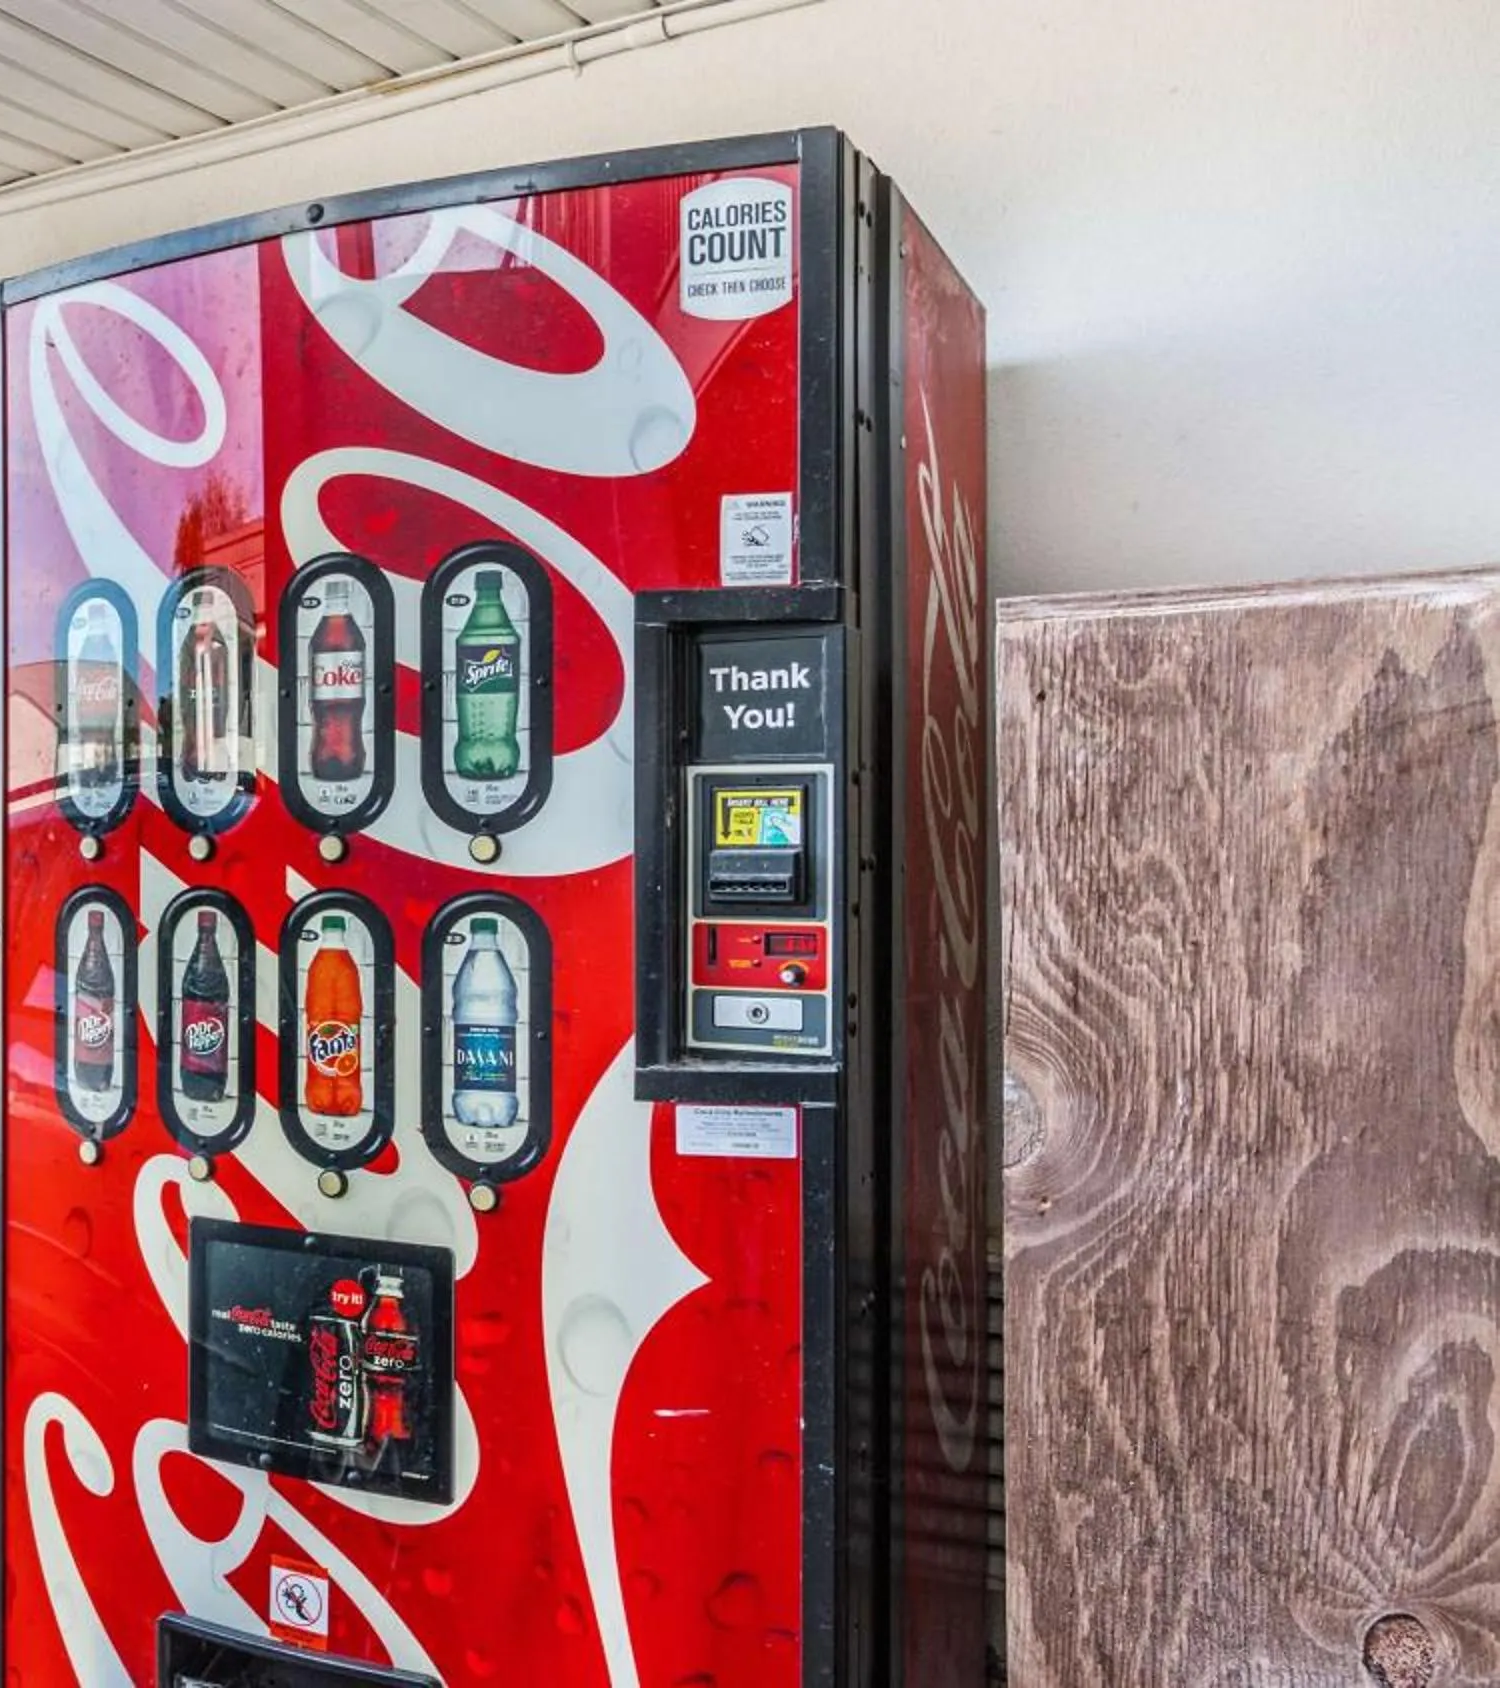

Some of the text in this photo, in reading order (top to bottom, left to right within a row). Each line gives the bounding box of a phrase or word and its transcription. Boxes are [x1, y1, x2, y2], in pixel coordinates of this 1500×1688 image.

[687, 200, 787, 231] CALORIES
[688, 227, 787, 265] COUNT
[687, 276, 786, 297] CHECK THEN CHOOSE
[311, 664, 363, 689] Coke
[465, 657, 509, 685] Sprite
[709, 662, 811, 692] Thank
[723, 702, 797, 730] You!
[919, 384, 979, 1474] Coca-Cola
[332, 1291, 364, 1305] try it!
[211, 1308, 231, 1320] real
[271, 1318, 297, 1332] taste
[238, 1322, 303, 1344] zero calories
[373, 1355, 406, 1370] zero
[338, 1355, 354, 1410] zero
